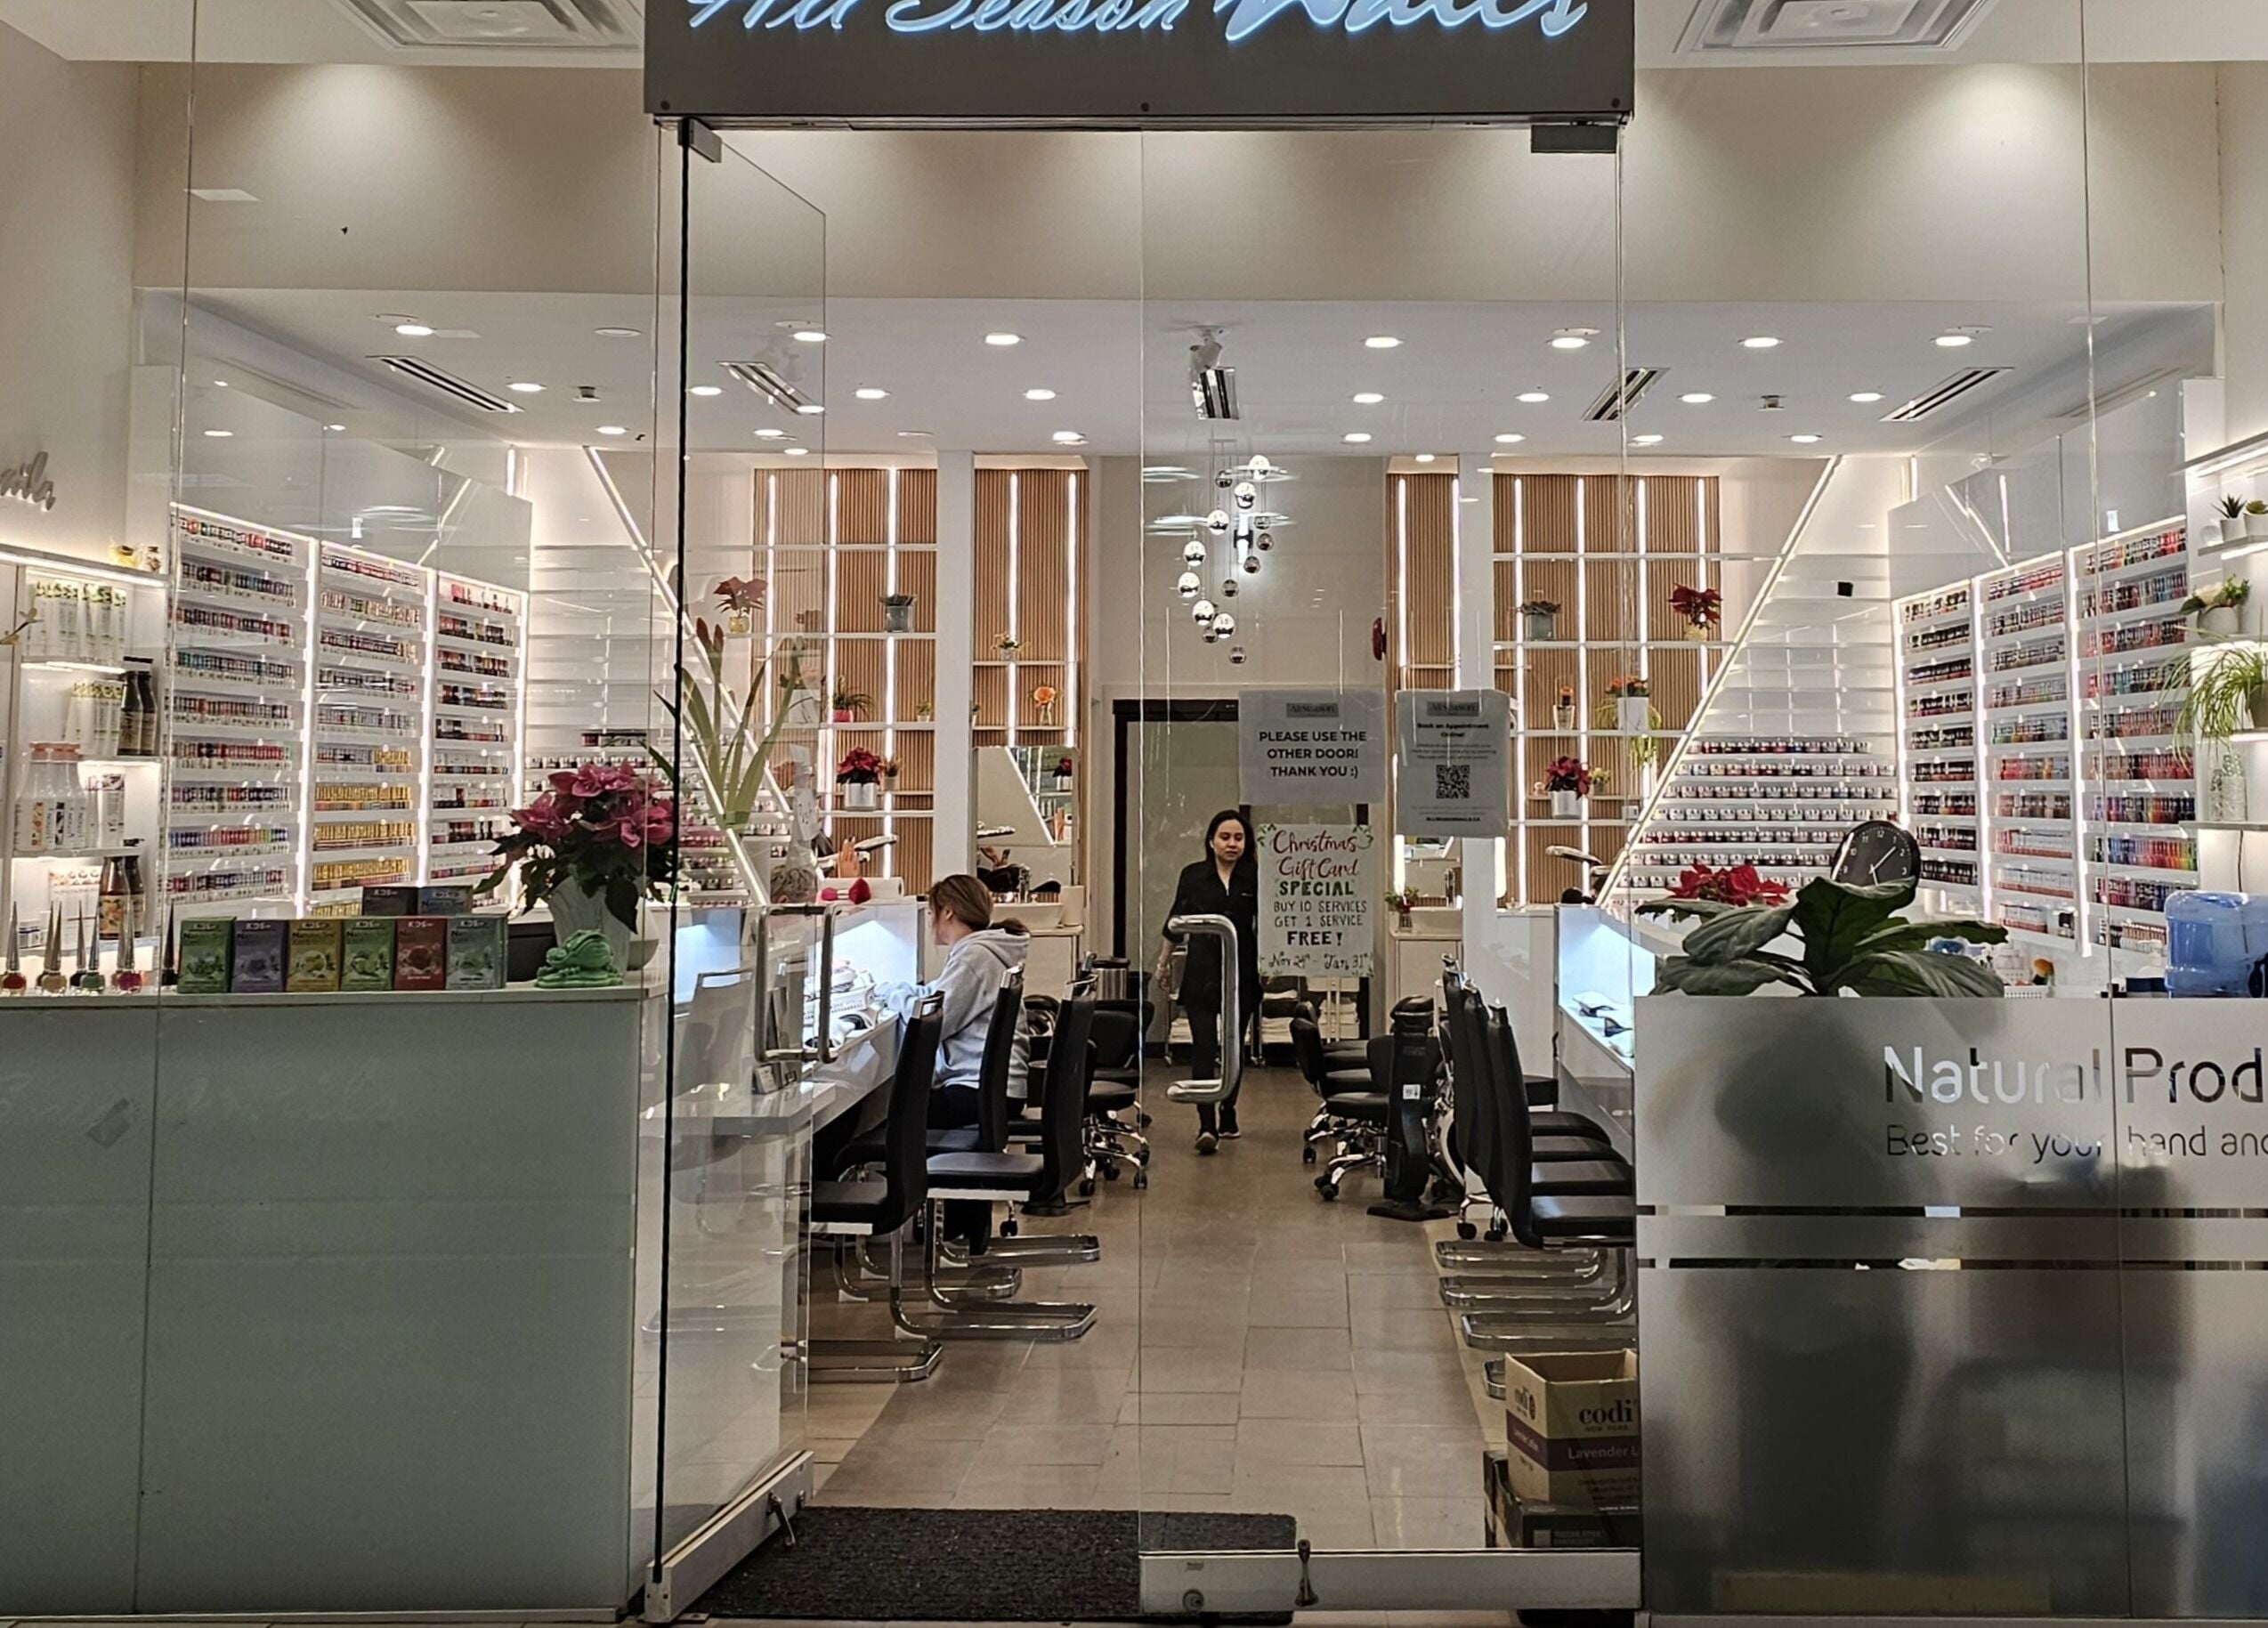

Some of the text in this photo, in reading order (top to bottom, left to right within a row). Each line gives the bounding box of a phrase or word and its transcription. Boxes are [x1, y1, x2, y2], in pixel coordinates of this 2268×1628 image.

[1259, 731, 1367, 741] PLEASE USE THE
[1267, 749, 1358, 759] OTHER DOOR!
[1270, 766, 1316, 777] THANK
[1319, 766, 1348, 777] YOU
[1273, 830, 1359, 854] Christmas
[1278, 855, 1359, 881] Gift Card
[1279, 880, 1354, 896] SPECIAL
[1273, 900, 1367, 913] BUY 10 SERVICES
[1274, 915, 1364, 927] GET 1 SERVICE
[1883, 1046, 2265, 1104] Natural Prod
[1886, 1123, 1961, 1157] Best
[1973, 1124, 2020, 1157] for
[2031, 1130, 2105, 1164] your
[2127, 1124, 2207, 1157] hand
[1579, 1398, 1633, 1424] codi
[1568, 1445, 1630, 1460] Lavender
